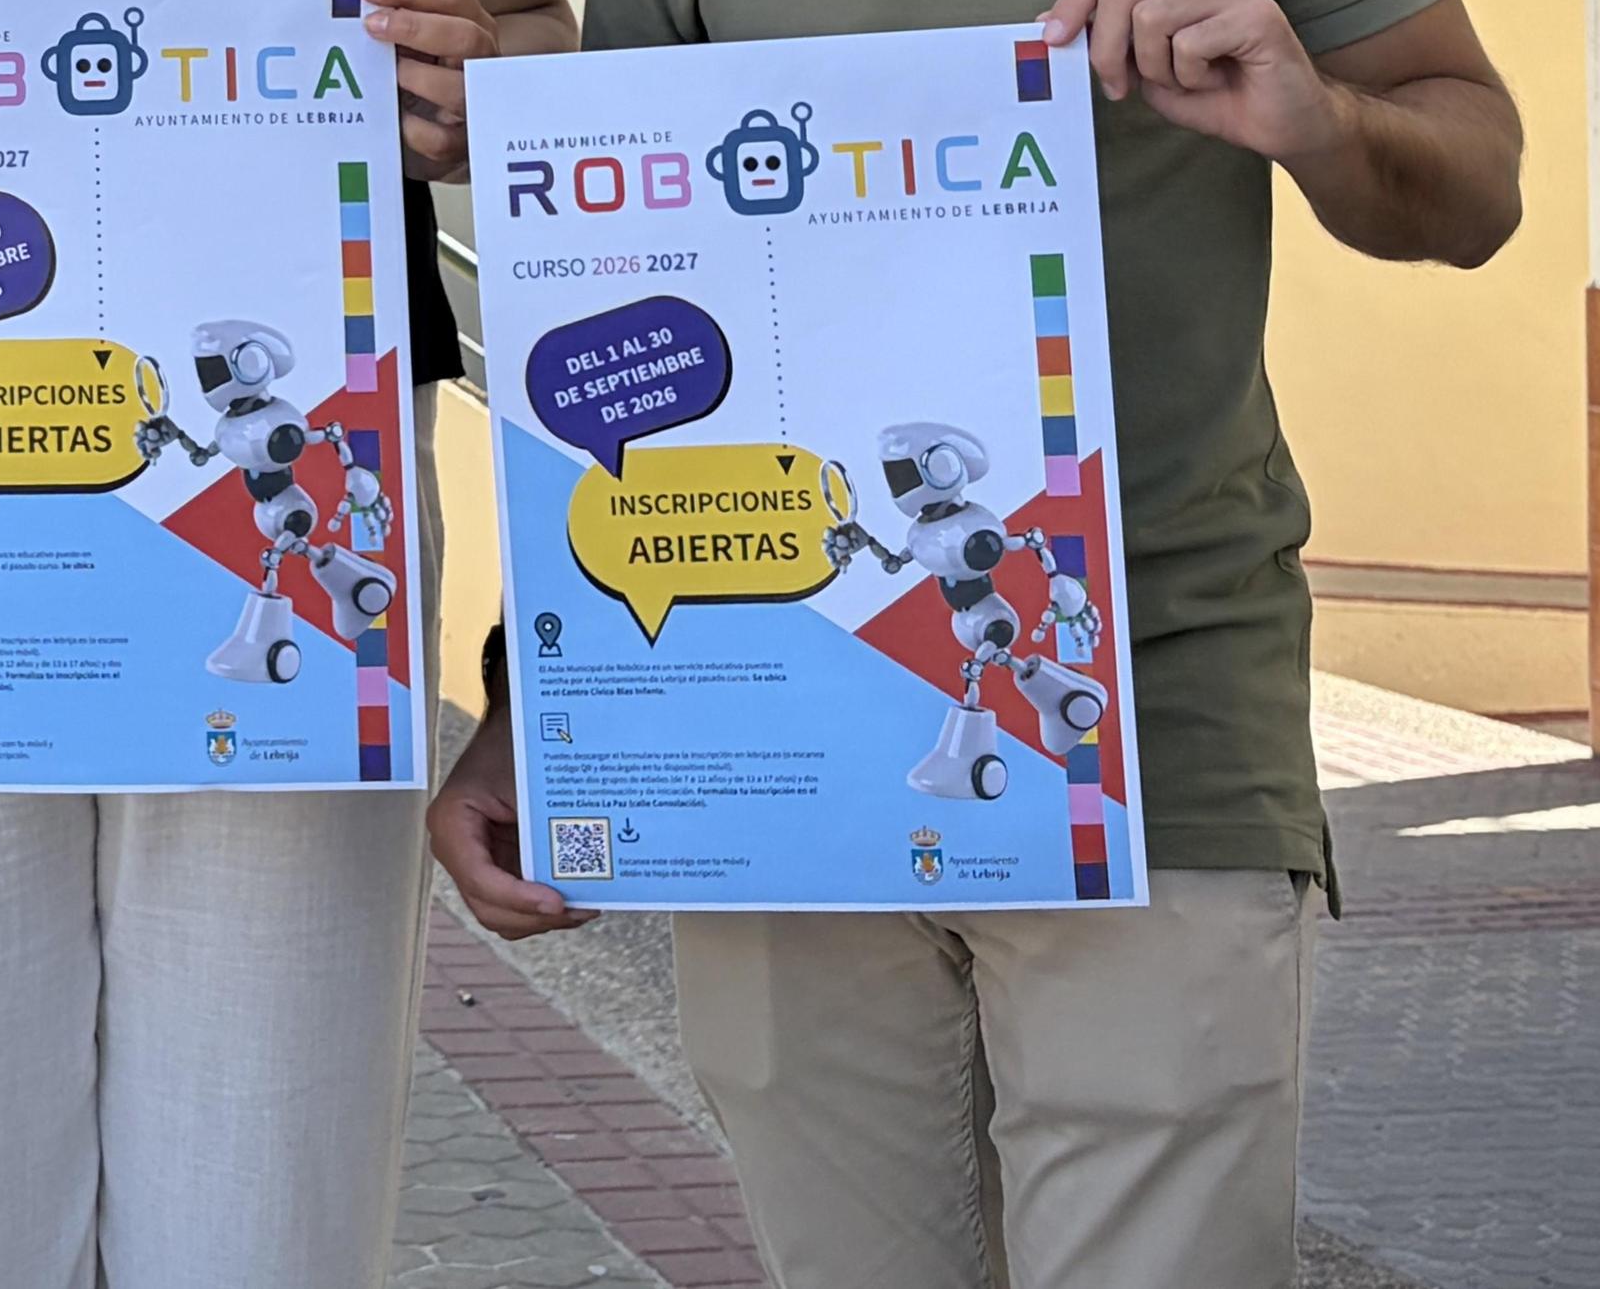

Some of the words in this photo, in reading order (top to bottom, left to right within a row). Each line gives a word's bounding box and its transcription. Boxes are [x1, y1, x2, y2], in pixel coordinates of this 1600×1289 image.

[135, 113, 264, 127] AYUNTAMIENTO
[269, 112, 289, 124] DE
[297, 111, 365, 124] LEBRIJA
[506, 139, 550, 152] AULA
[554, 131, 648, 149] MUNICIPAL
[653, 130, 673, 143] DE
[808, 207, 947, 226] AYUNTAMIENTO
[952, 204, 974, 218] DE
[982, 201, 1060, 216] LEBRIJA
[512, 258, 586, 280] CURSO
[591, 255, 642, 276] 2026
[646, 252, 699, 273] 2027
[566, 350, 605, 375] DEL
[606, 345, 620, 362] 1
[623, 337, 647, 358] AL
[648, 327, 673, 348] 30
[554, 386, 583, 408] DE
[583, 346, 705, 399] SEPTIEMBRE
[600, 401, 629, 423] DE
[630, 386, 677, 415] 2026
[610, 488, 813, 516] INSCRIPCIONES
[628, 531, 801, 565] ABIERTAS
[948, 855, 1020, 868] Ayuntamiento
[958, 869, 969, 879] de
[972, 868, 1011, 881] Lebrija
